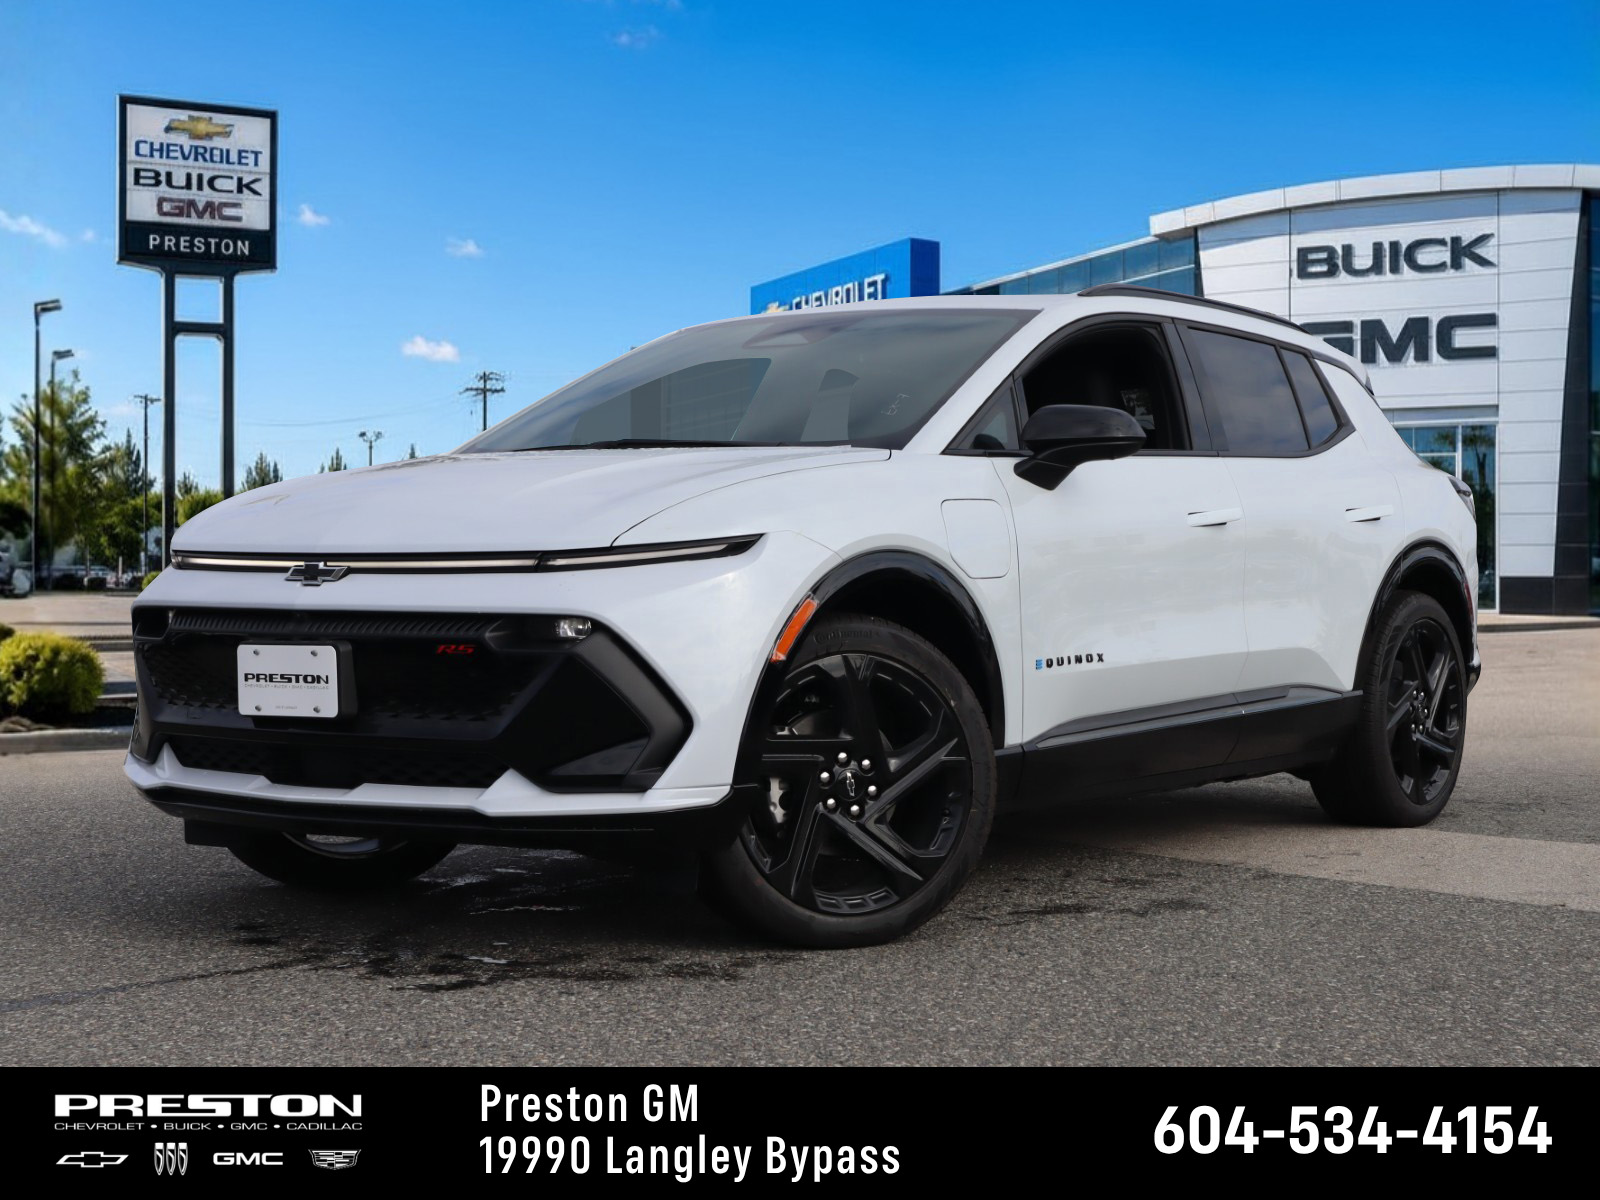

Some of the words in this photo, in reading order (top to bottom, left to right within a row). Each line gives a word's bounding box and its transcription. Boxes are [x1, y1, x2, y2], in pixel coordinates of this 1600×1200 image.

[134, 139, 263, 168] CHEVROLET
[133, 167, 262, 197] BUICK
[156, 196, 243, 223] GMC
[149, 234, 250, 257] PRESTON
[1296, 232, 1497, 281] BUICK
[791, 272, 887, 311] CHEVROLET
[436, 644, 477, 655] RS
[1035, 652, 1105, 671] EQUINOX
[244, 672, 329, 685] PRESTON
